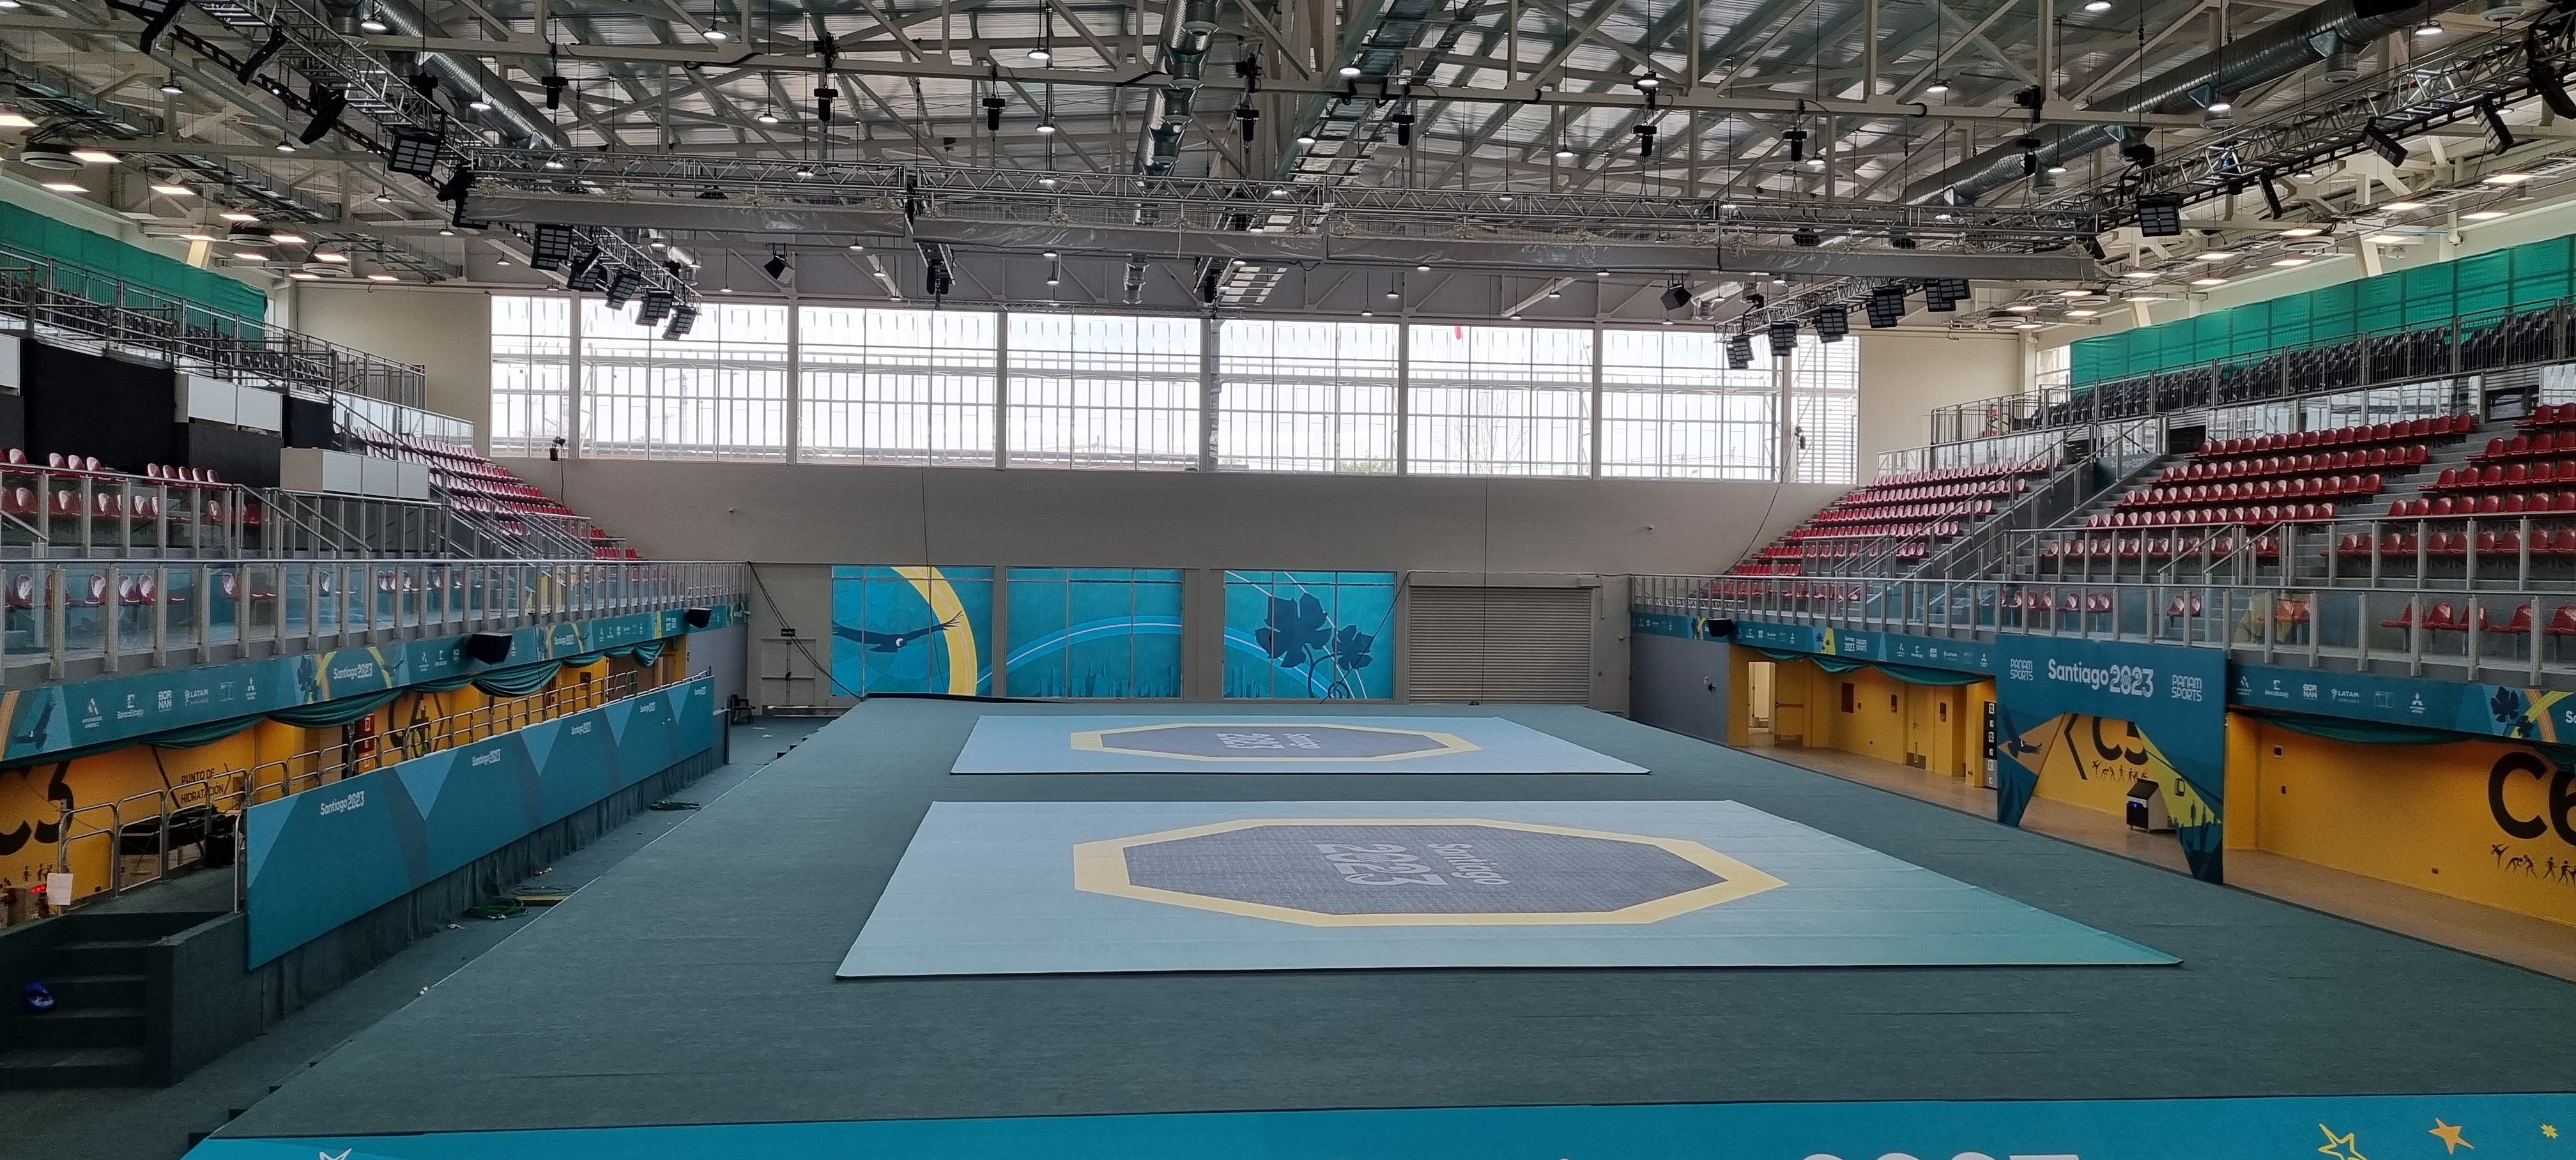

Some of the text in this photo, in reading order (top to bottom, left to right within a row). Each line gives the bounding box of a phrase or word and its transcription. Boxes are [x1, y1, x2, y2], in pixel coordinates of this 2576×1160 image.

[2010, 659, 2032, 670] PANAM
[2010, 669, 2034, 681] SPORTS
[2048, 659, 2154, 698] Santiago 2023
[2172, 674, 2202, 689] PANAM
[2172, 687, 2202, 701] SPORTS
[181, 770, 204, 784] PUNTO
[180, 782, 224, 804] HIDRATIÓN
[320, 790, 365, 816] Santiago 2023
[1315, 843, 1449, 886] 2023
[1427, 843, 1510, 885] Santiago
